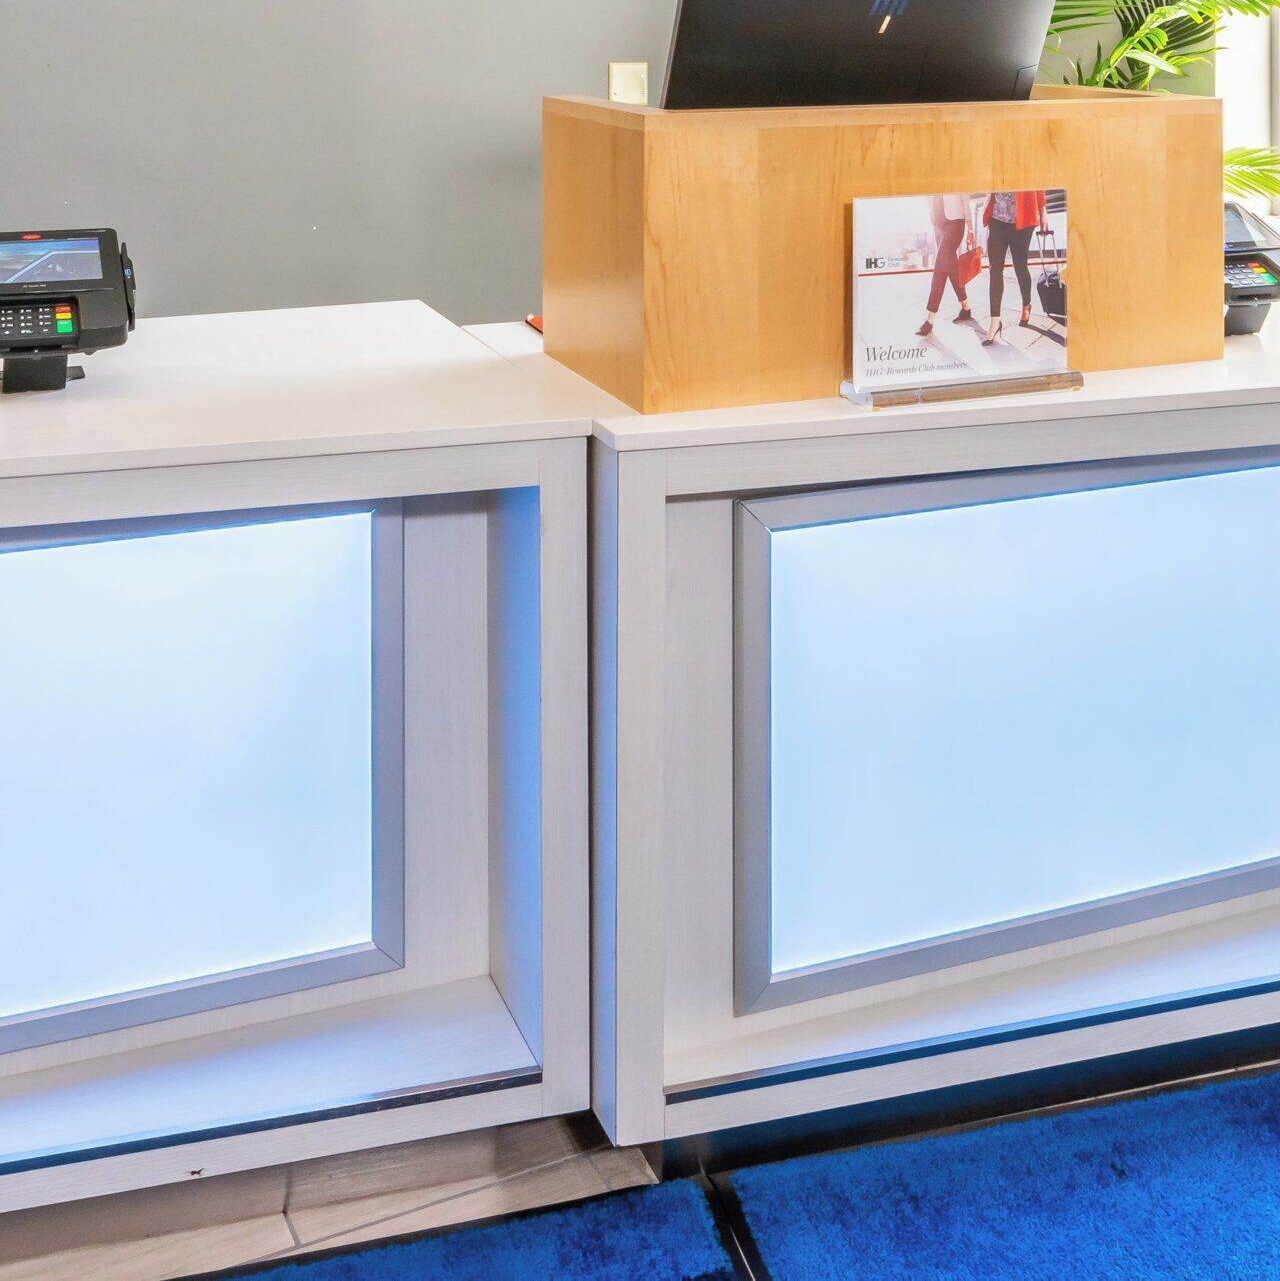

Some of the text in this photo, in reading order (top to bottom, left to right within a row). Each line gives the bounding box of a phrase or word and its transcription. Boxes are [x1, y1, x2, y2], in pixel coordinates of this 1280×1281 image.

[865, 257, 886, 270] IHG
[865, 345, 928, 362] Welcome
[886, 365, 917, 376] Rewards
[918, 363, 936, 373] Club
